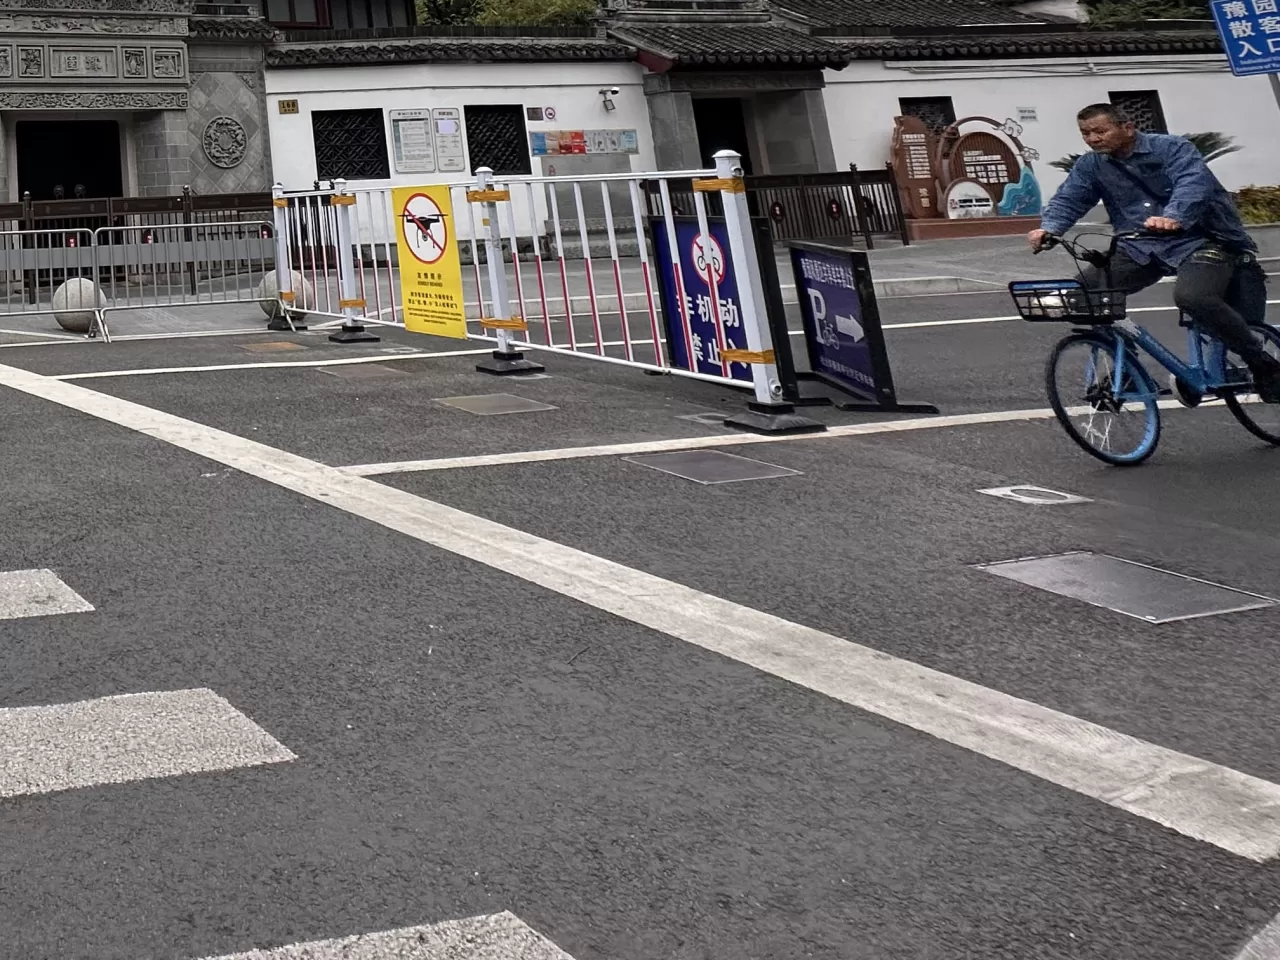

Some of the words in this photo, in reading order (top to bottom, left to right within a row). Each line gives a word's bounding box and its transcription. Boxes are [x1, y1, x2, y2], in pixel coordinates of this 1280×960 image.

[1228, 16, 1280, 38] 散客
[1238, 38, 1280, 57] 入口
[807, 287, 827, 344] P
